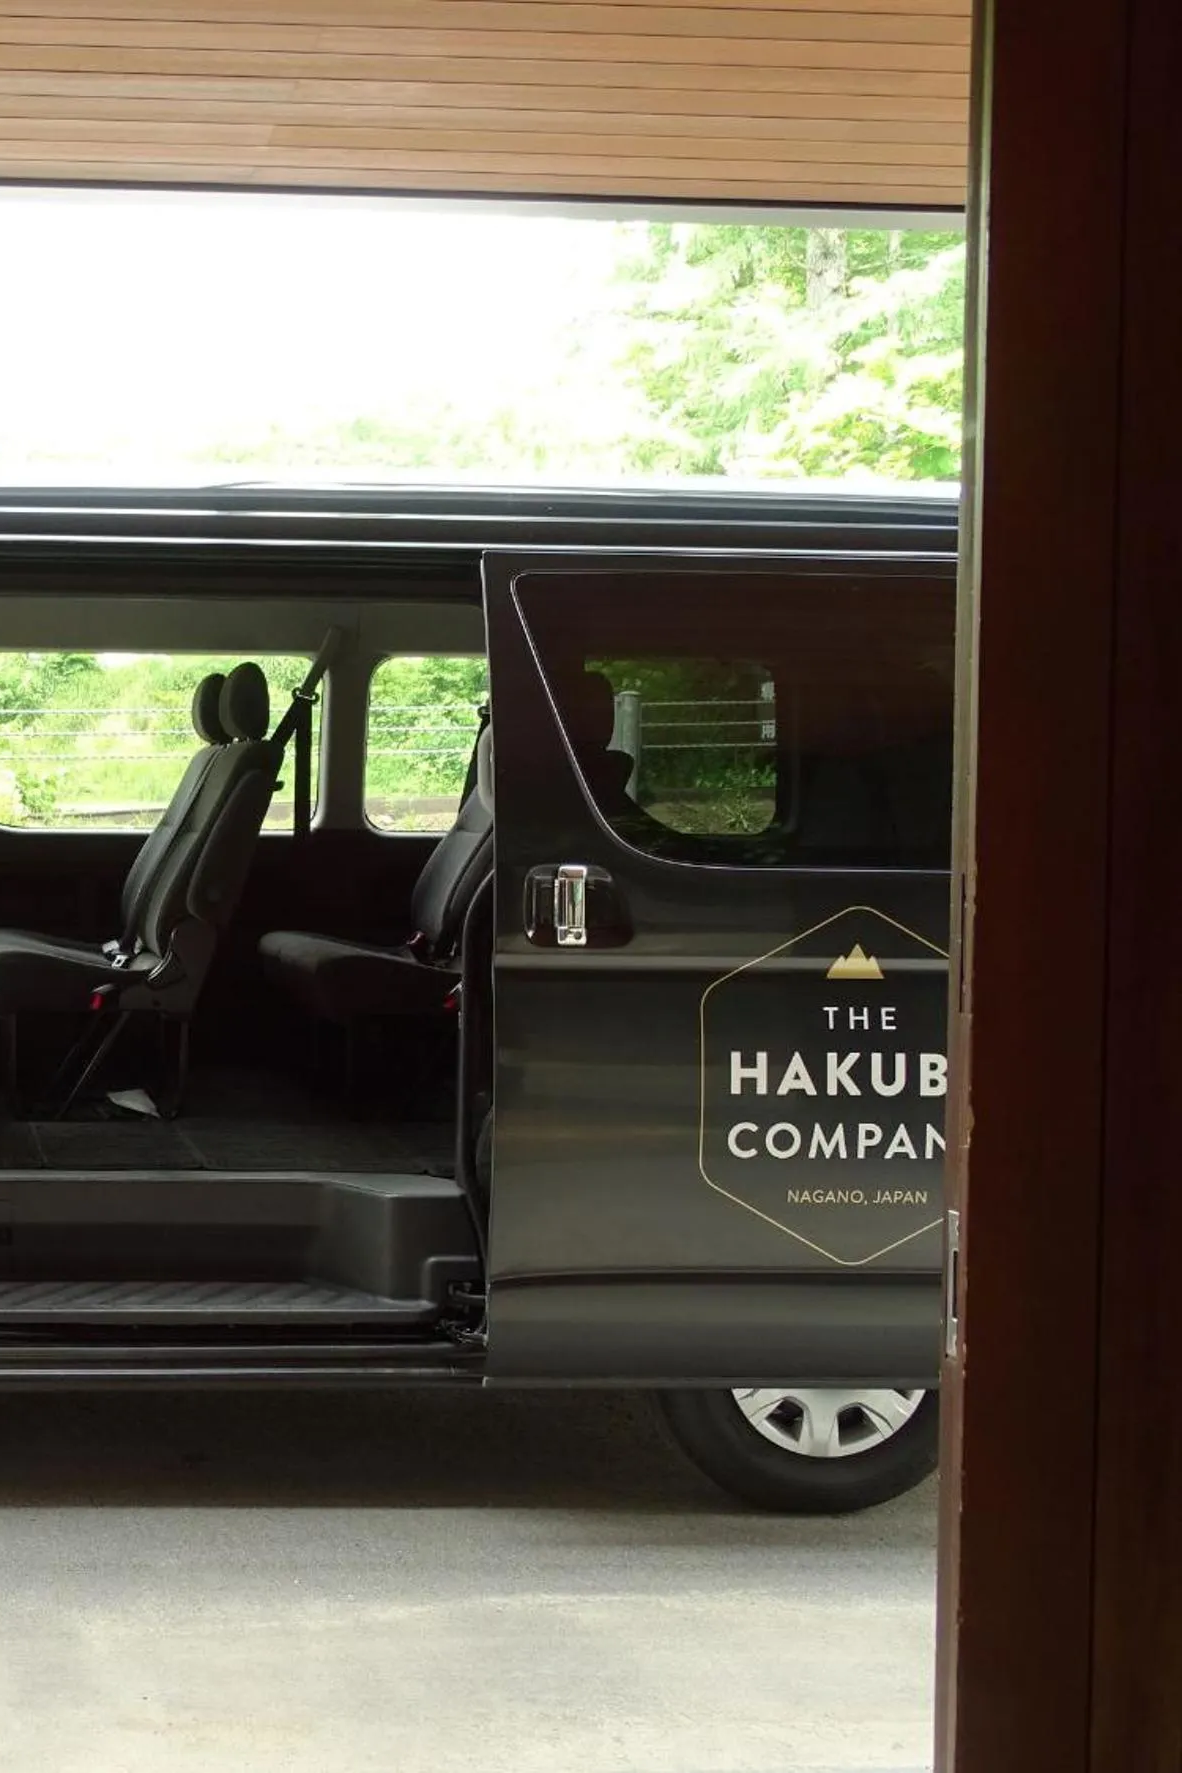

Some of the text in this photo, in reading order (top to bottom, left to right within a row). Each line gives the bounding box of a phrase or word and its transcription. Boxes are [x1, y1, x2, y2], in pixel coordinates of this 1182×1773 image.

[822, 1006, 897, 1030] THE
[729, 1050, 948, 1097] HAKUB
[727, 1121, 946, 1160] COMPAN
[786, 1188, 929, 1206] NAGANO, JAPAN
